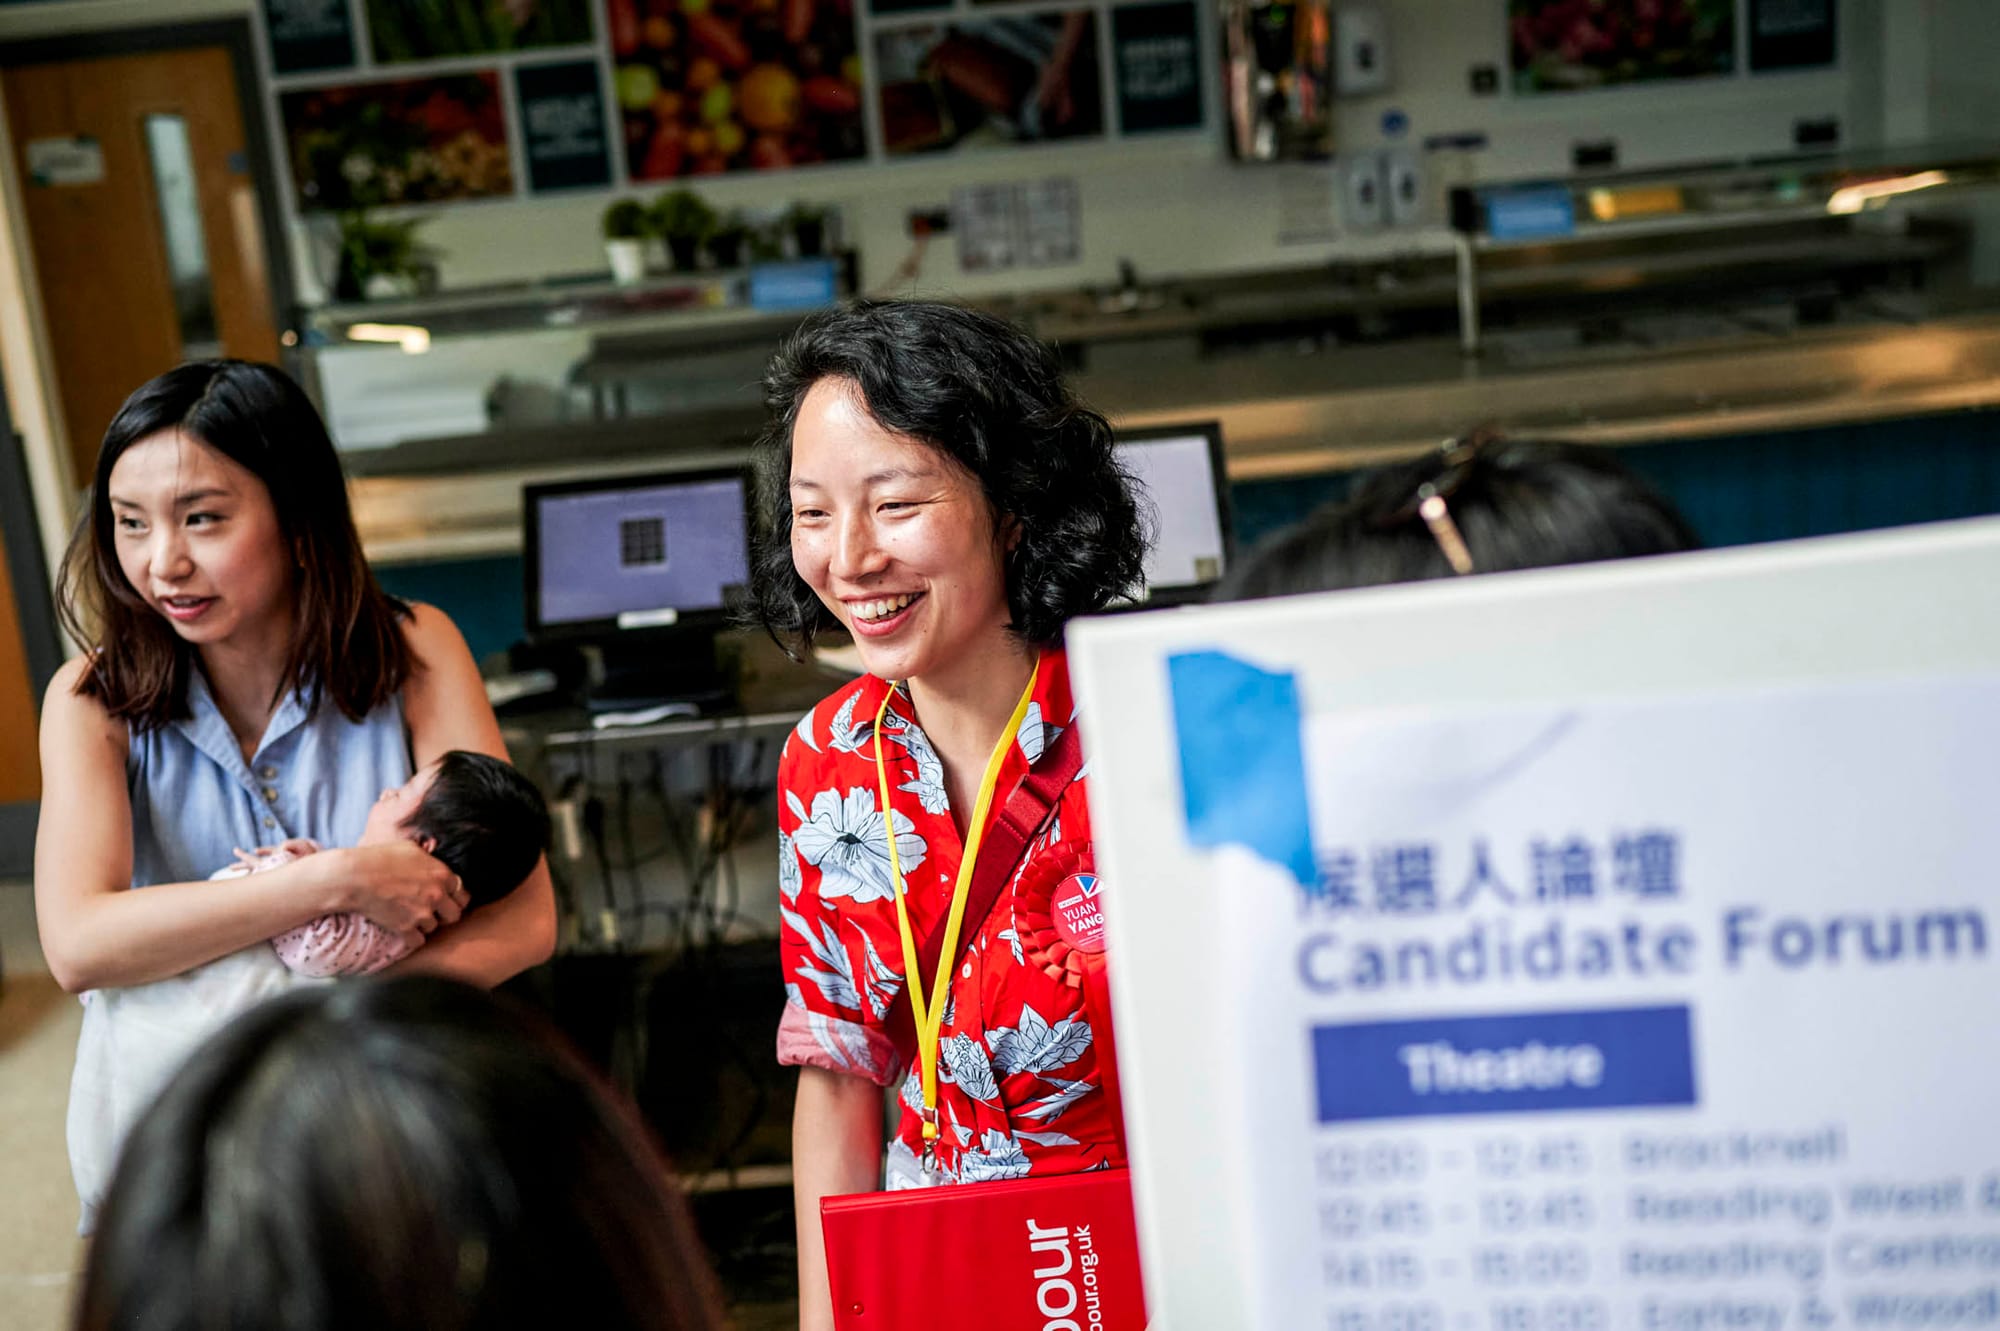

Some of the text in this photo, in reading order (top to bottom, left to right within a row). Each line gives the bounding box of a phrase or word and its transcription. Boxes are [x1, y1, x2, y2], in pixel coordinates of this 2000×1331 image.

[1062, 901, 1097, 922] YUAN
[1067, 913, 1104, 934] YANG
[1298, 904, 1987, 993] Candidate Forum
[1399, 1040, 1603, 1094] Theatre
